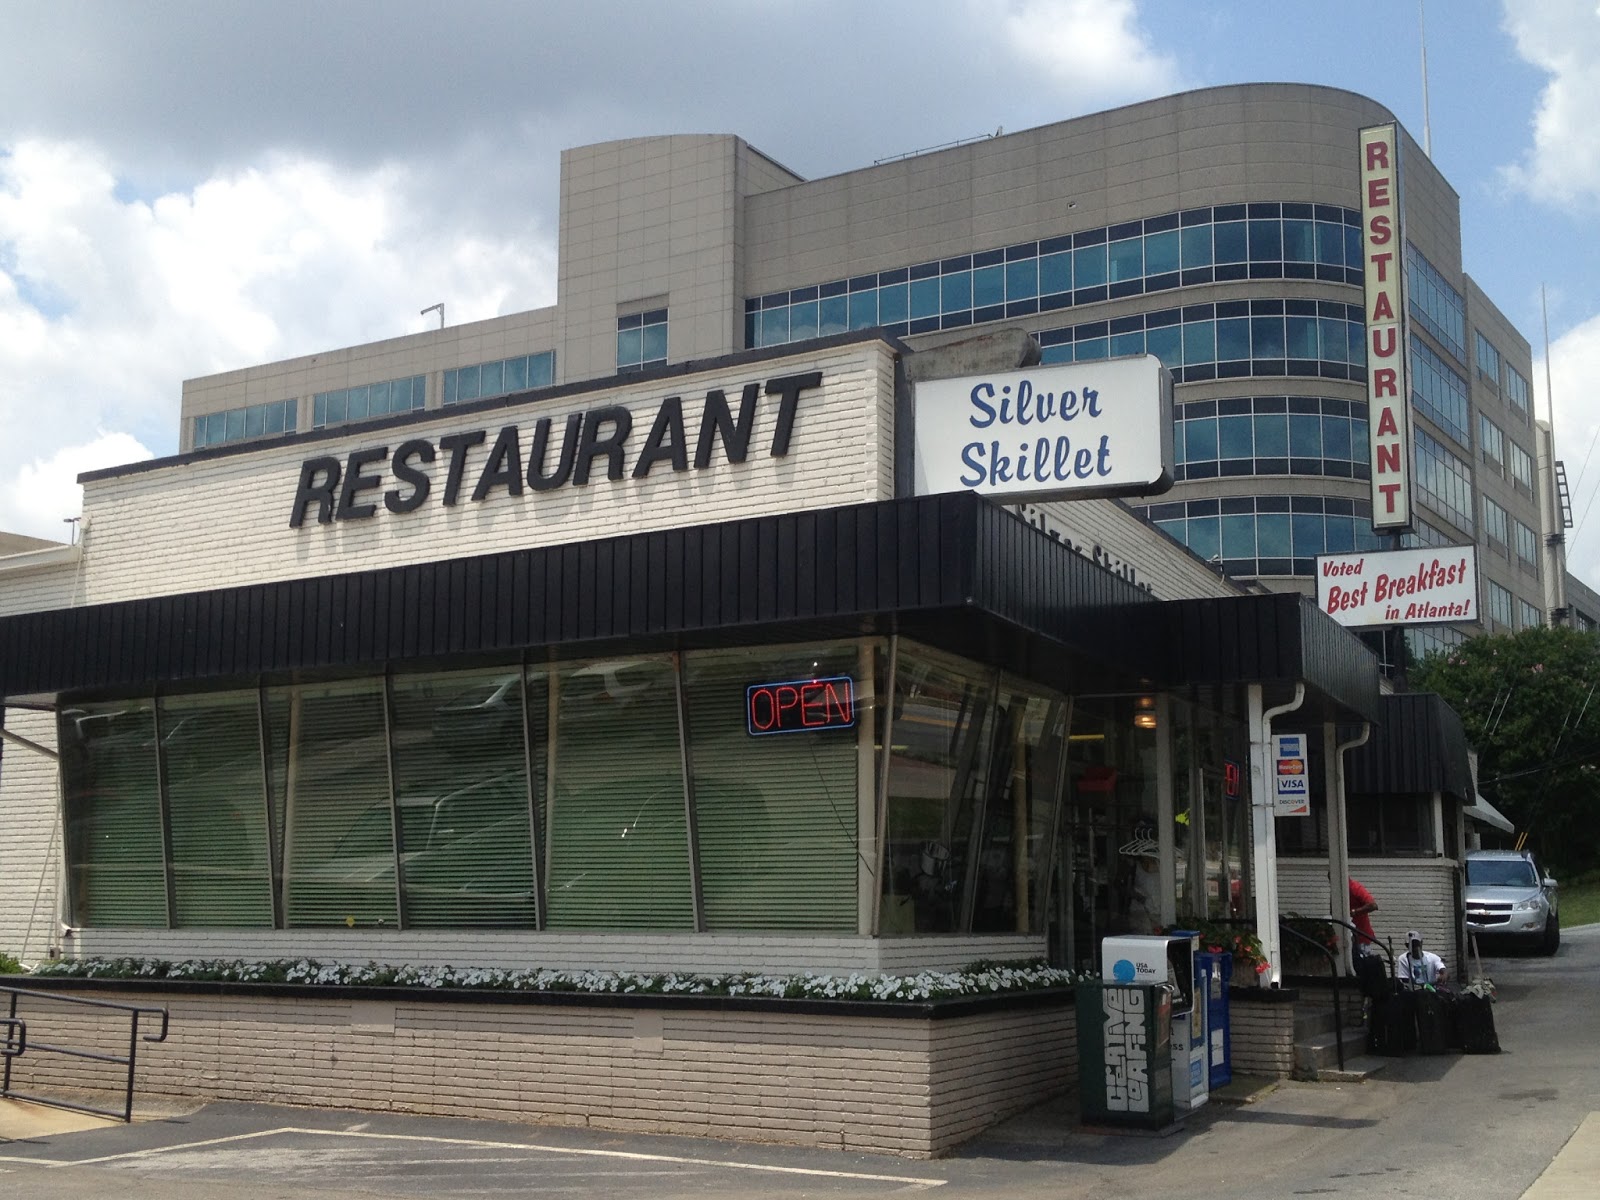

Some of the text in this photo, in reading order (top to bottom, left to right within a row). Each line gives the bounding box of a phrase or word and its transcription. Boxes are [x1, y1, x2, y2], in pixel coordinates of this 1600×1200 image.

[1366, 141, 1401, 513] RESTAURANT
[969, 380, 1103, 428] Silver
[289, 371, 822, 529] RESTAURANT
[959, 435, 1112, 486] Skillet
[1323, 558, 1364, 577] Voted
[1327, 558, 1467, 614] Best Breakfast
[1385, 599, 1470, 620] in Atlanta!
[751, 682, 850, 730] OPEN
[1281, 780, 1304, 788] VISA
